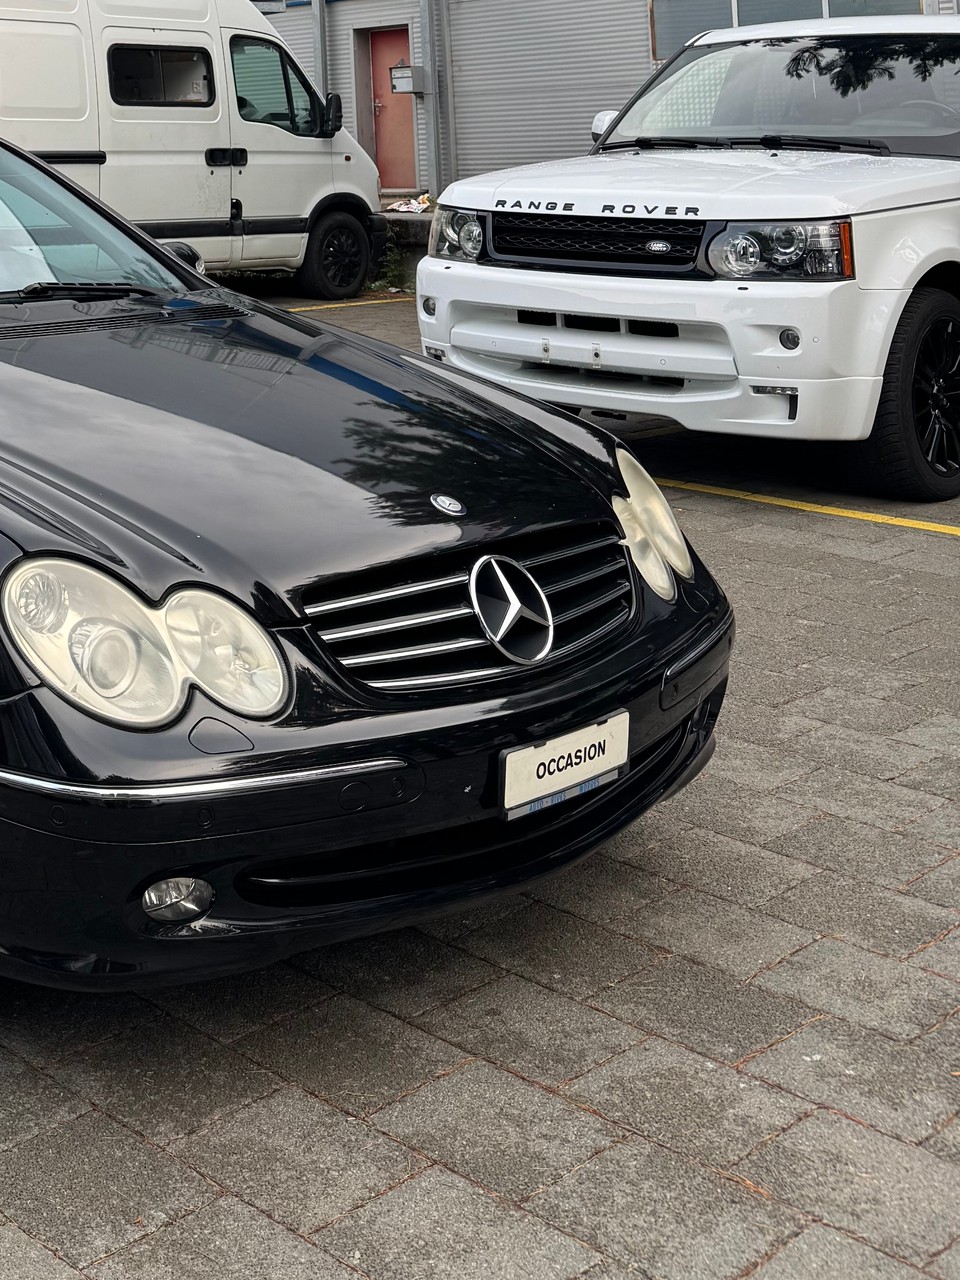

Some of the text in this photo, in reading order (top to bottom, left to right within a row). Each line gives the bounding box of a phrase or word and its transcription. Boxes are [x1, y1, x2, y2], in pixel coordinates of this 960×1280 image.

[495, 199, 700, 216] RANGE ROVER
[536, 739, 606, 780] OCCASION
